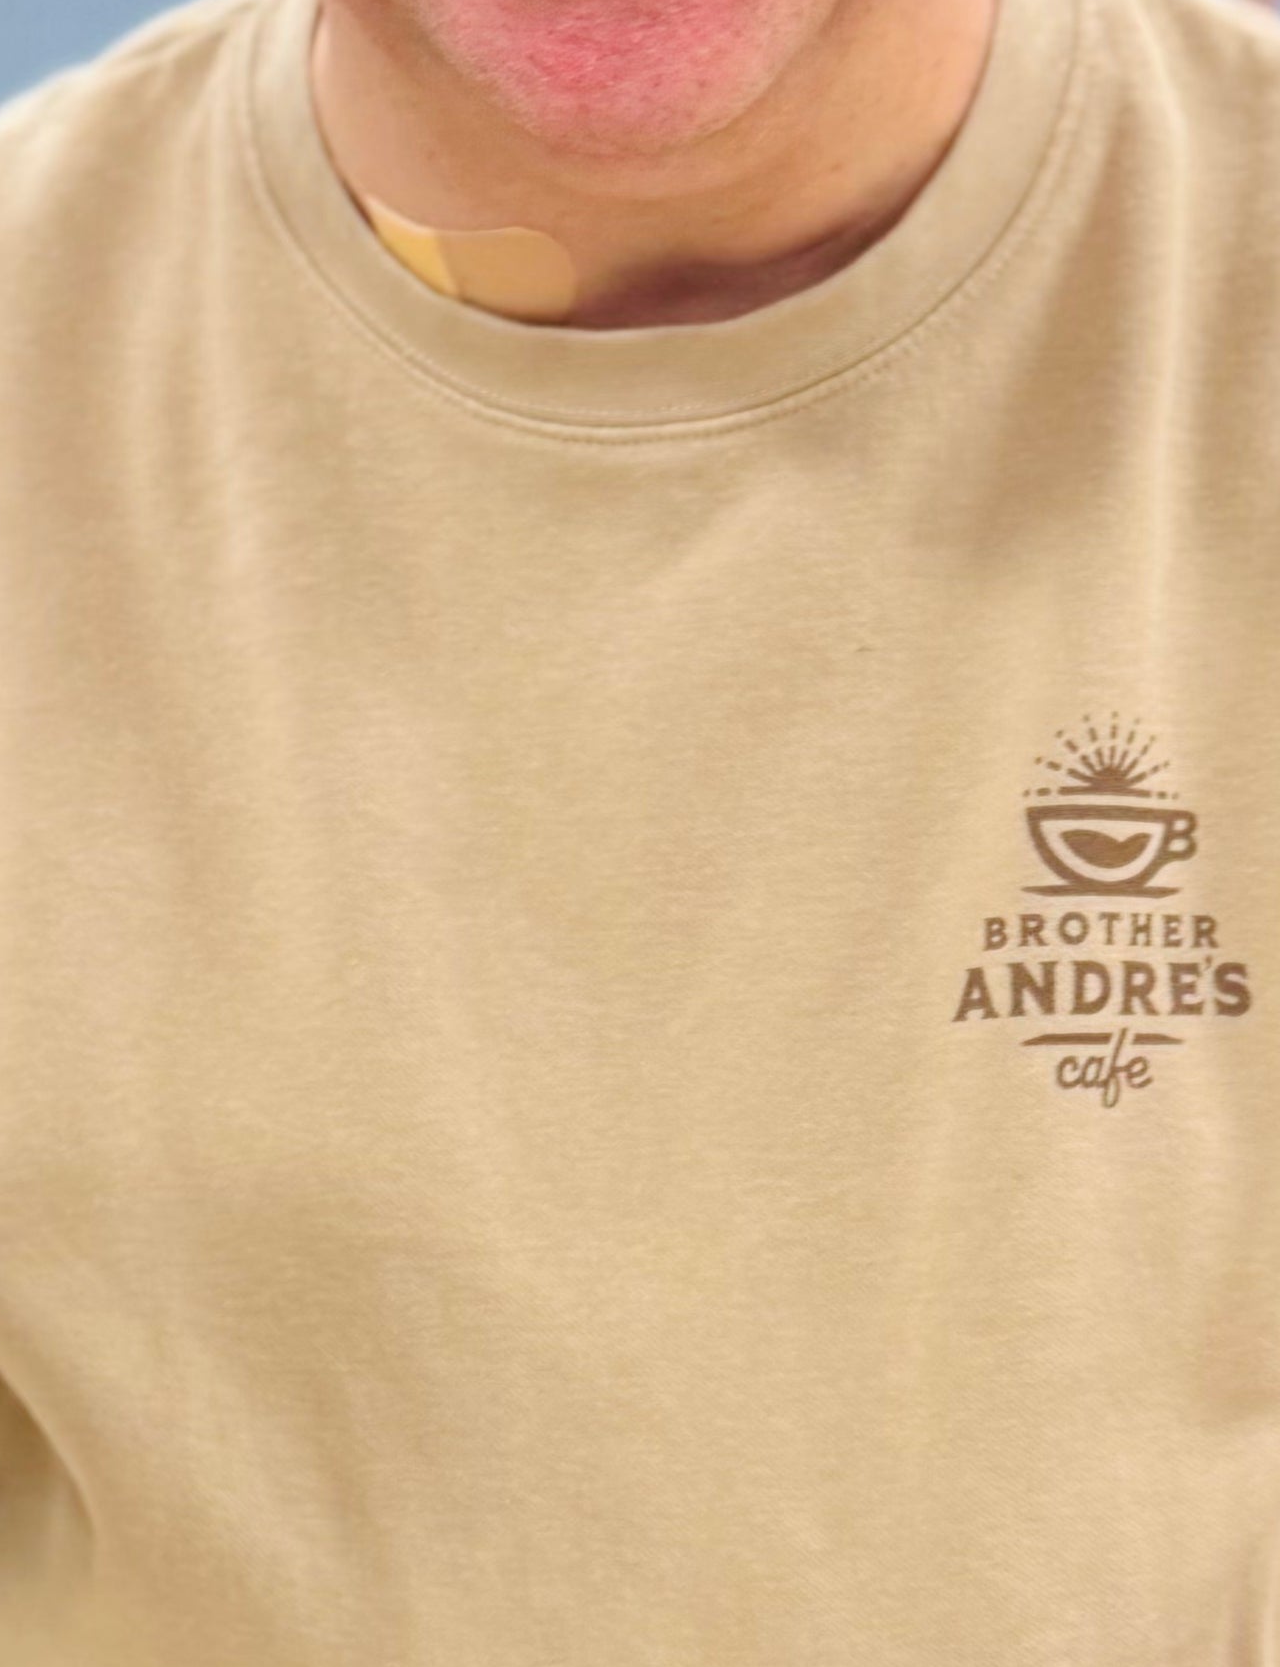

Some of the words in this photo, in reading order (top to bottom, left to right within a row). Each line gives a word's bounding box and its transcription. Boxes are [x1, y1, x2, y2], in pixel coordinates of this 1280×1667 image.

[982, 910, 1220, 951] BROTHER
[951, 954, 1254, 1023] ANDRE'S
[1056, 1027, 1153, 1108] cafe
